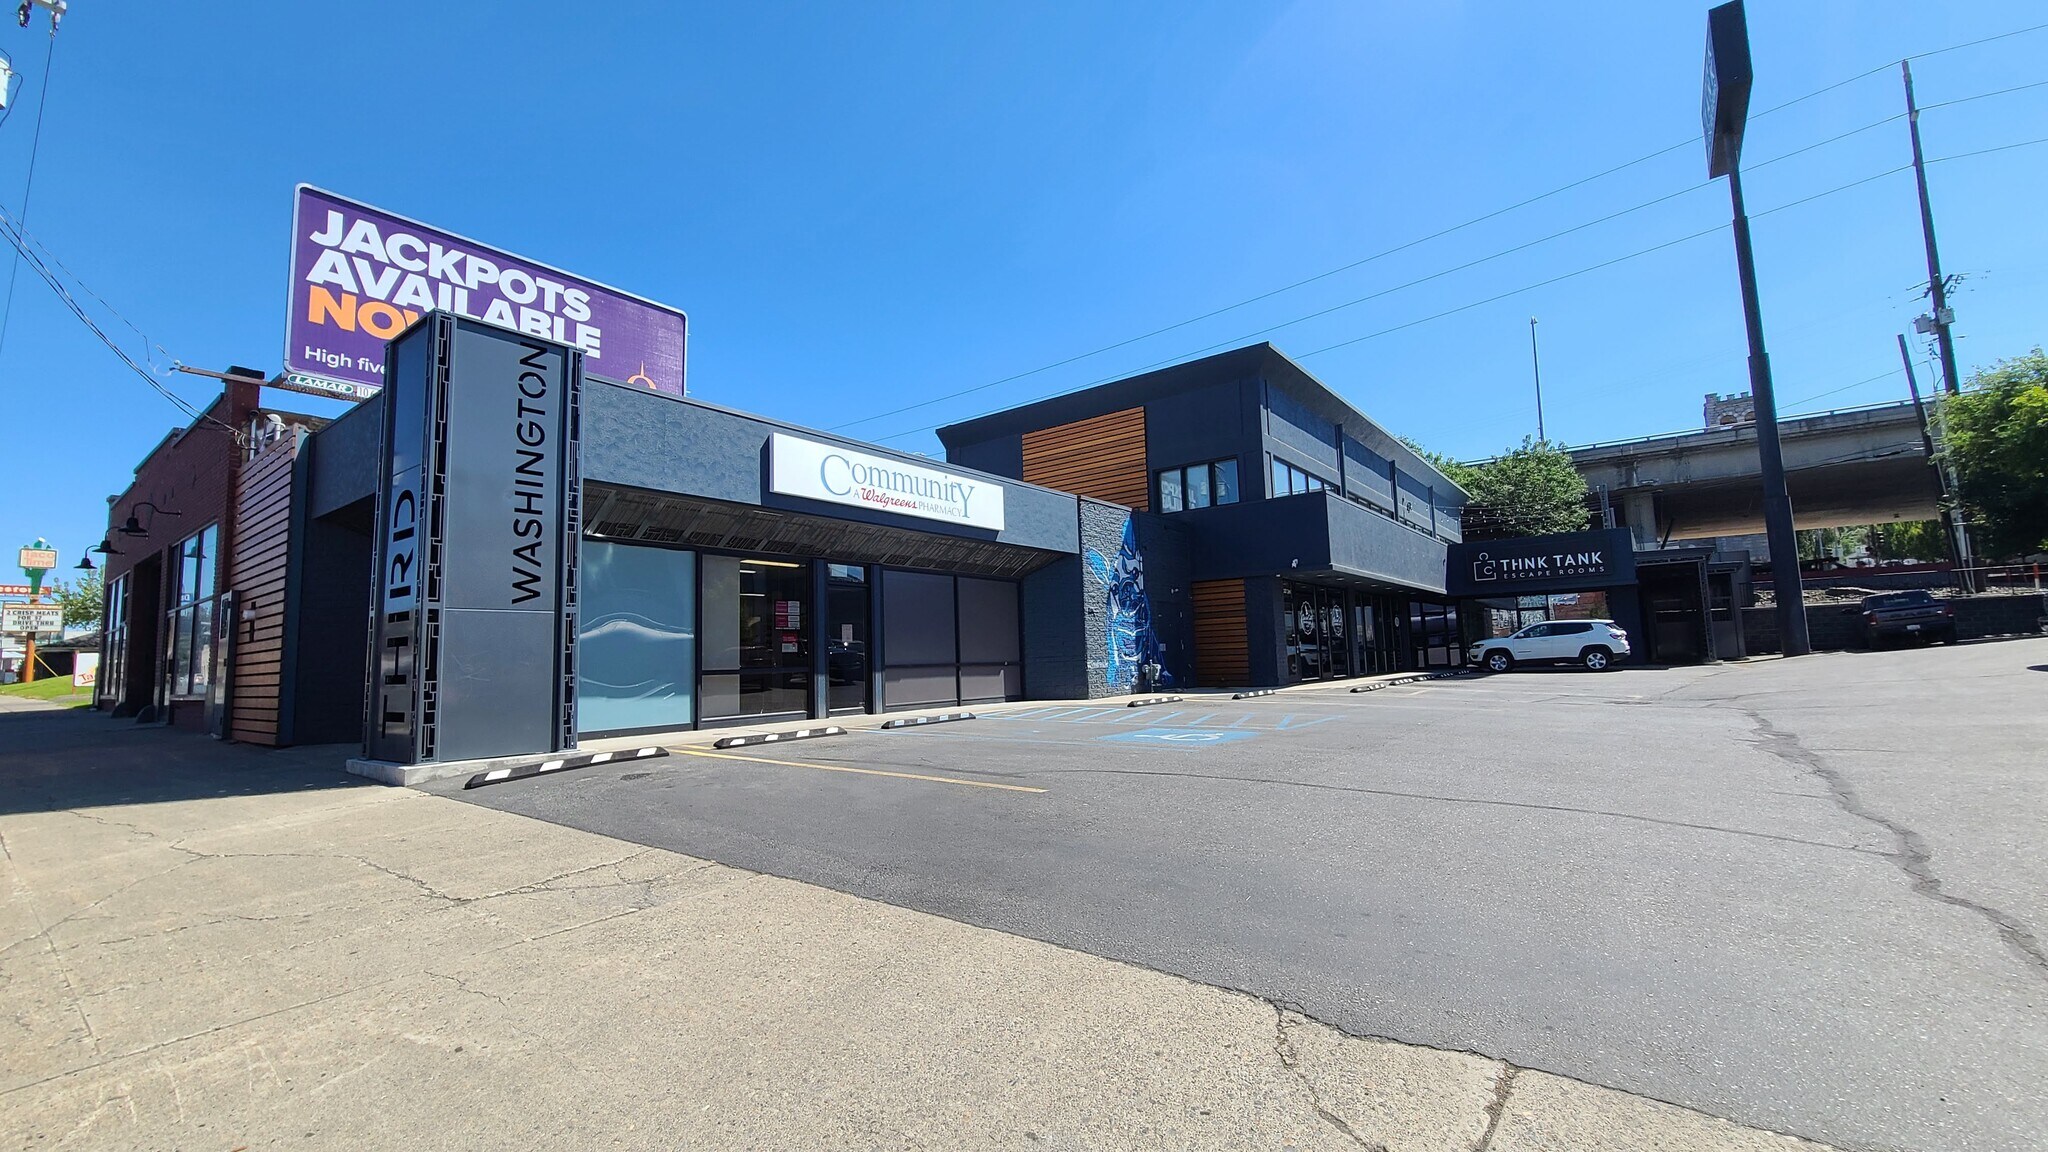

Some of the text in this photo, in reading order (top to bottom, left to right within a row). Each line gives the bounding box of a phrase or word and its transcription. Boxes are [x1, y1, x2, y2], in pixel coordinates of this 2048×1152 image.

[309, 209, 591, 322] JACKPOTS
[305, 249, 601, 359] AVAILABLE
[304, 345, 352, 368] High
[294, 375, 346, 392] LAMAR
[511, 342, 549, 605] WASHINGTON
[853, 487, 963, 518] A Walgreens PHARMACY
[1503, 566, 1605, 579] ESCAPE ROOMS
[1553, 551, 1603, 567] TANK
[382, 489, 416, 739] THIRD
